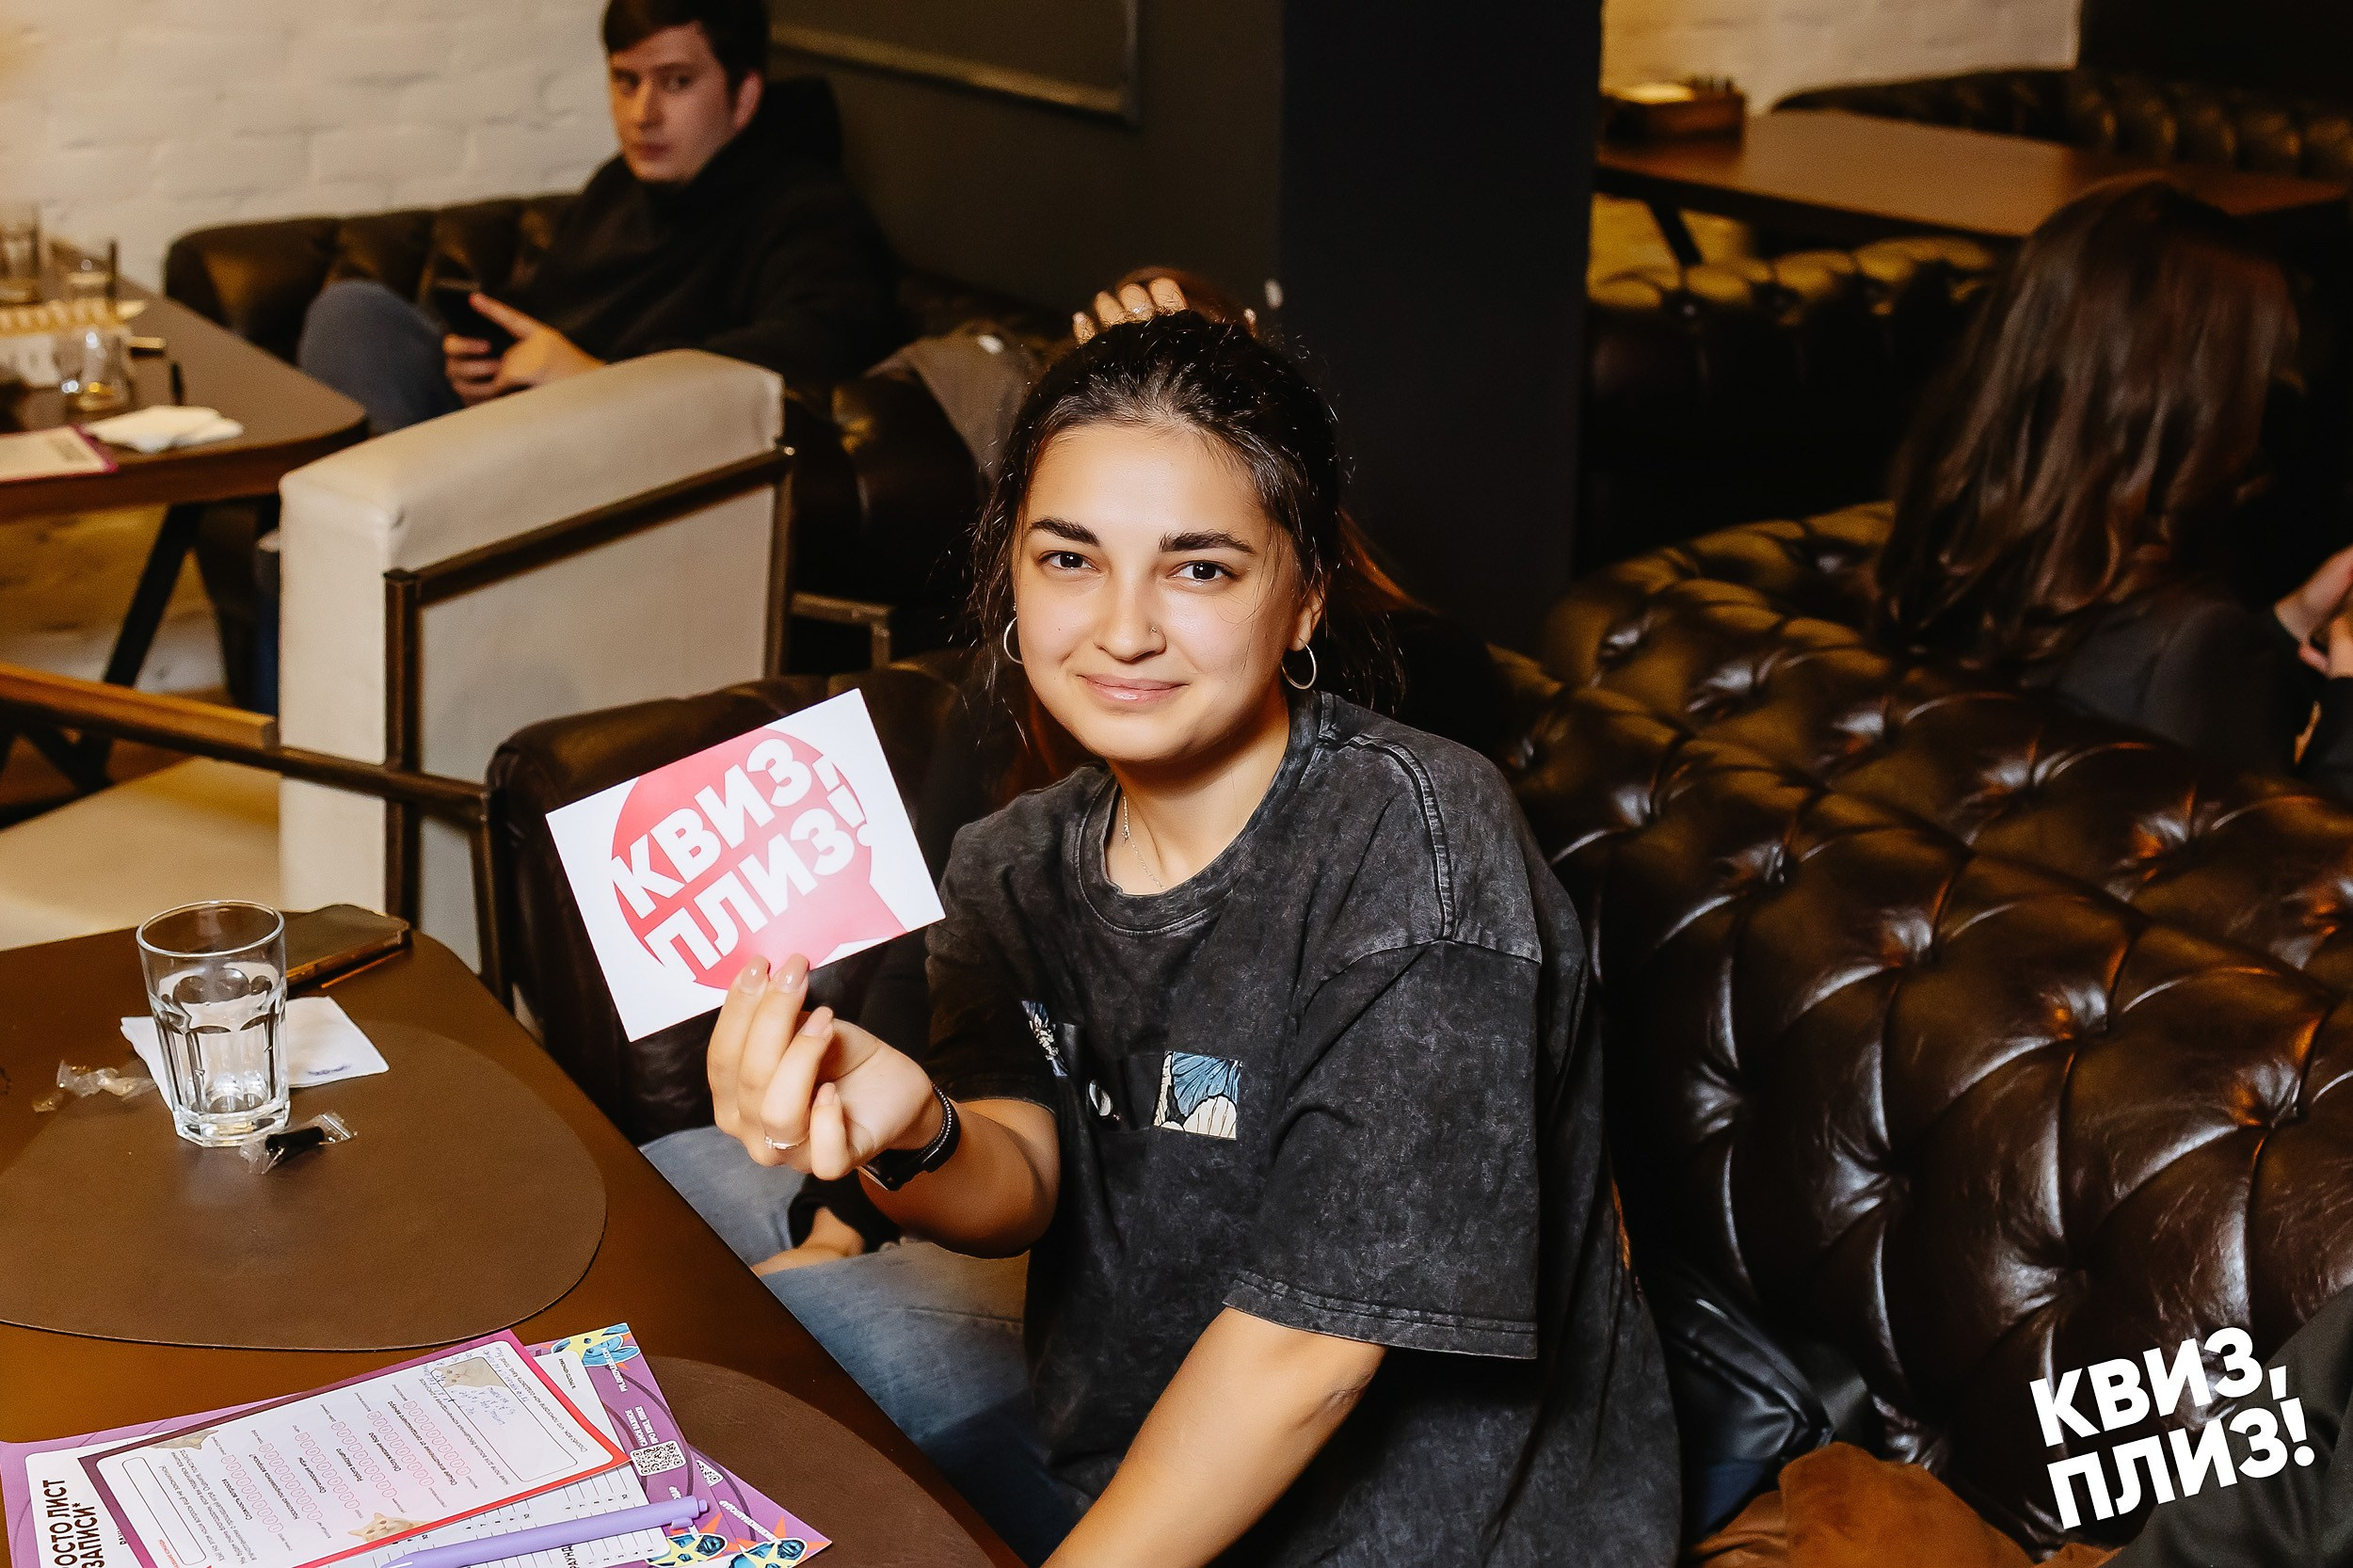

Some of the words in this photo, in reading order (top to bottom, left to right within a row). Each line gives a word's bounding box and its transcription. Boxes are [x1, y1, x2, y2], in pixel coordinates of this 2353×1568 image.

[612, 738, 840, 919] КВИЗ,
[644, 785, 872, 983] ПЛИЗ!
[42, 1480, 71, 1518] ЛИСТ
[50, 1522, 77, 1568] ОСТО
